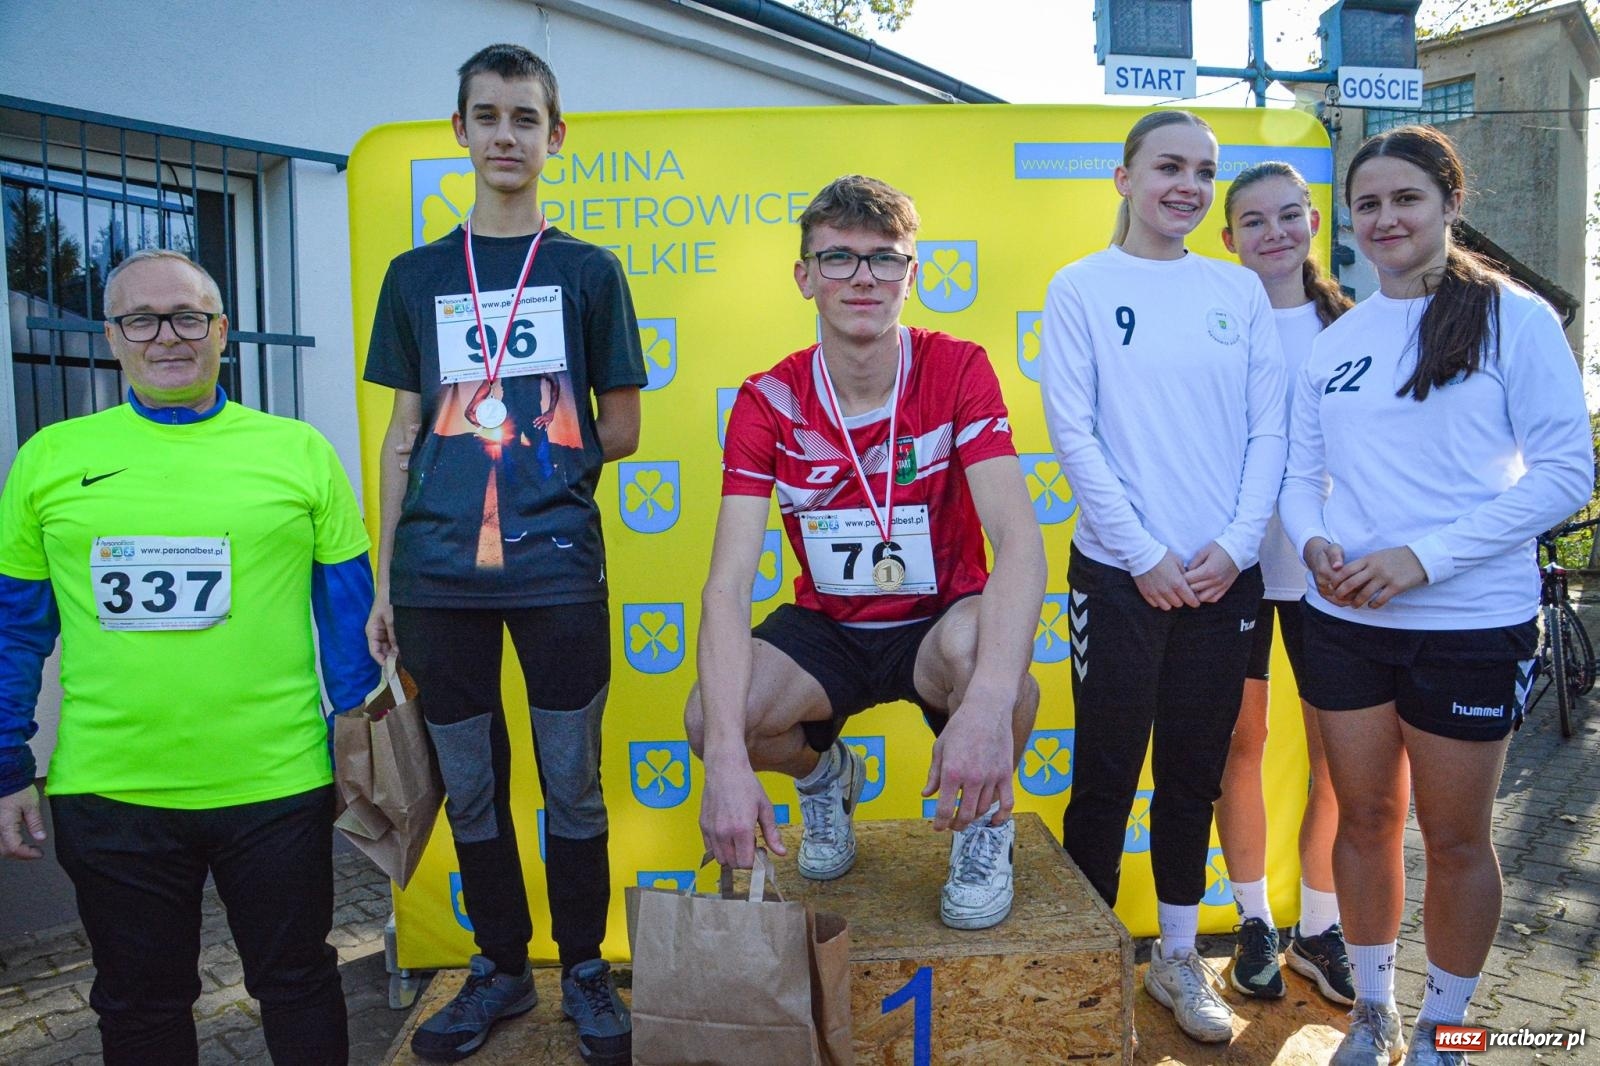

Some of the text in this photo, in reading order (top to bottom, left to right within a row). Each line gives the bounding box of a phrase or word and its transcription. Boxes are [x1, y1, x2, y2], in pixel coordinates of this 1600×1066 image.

[1115, 66, 1186, 92] START
[1342, 73, 1419, 101] GOŚCIE
[540, 149, 685, 185] GMINA
[541, 192, 810, 231] PIETROWICE
[465, 319, 538, 364] 96
[1115, 306, 1136, 346] 9
[1324, 355, 1372, 395] 22
[140, 546, 223, 556] www.personalbest.pl
[831, 541, 906, 580] 76
[100, 570, 223, 614] 337
[881, 565, 895, 583] 1
[1452, 701, 1504, 718] hummel
[881, 966, 933, 1066] 1
